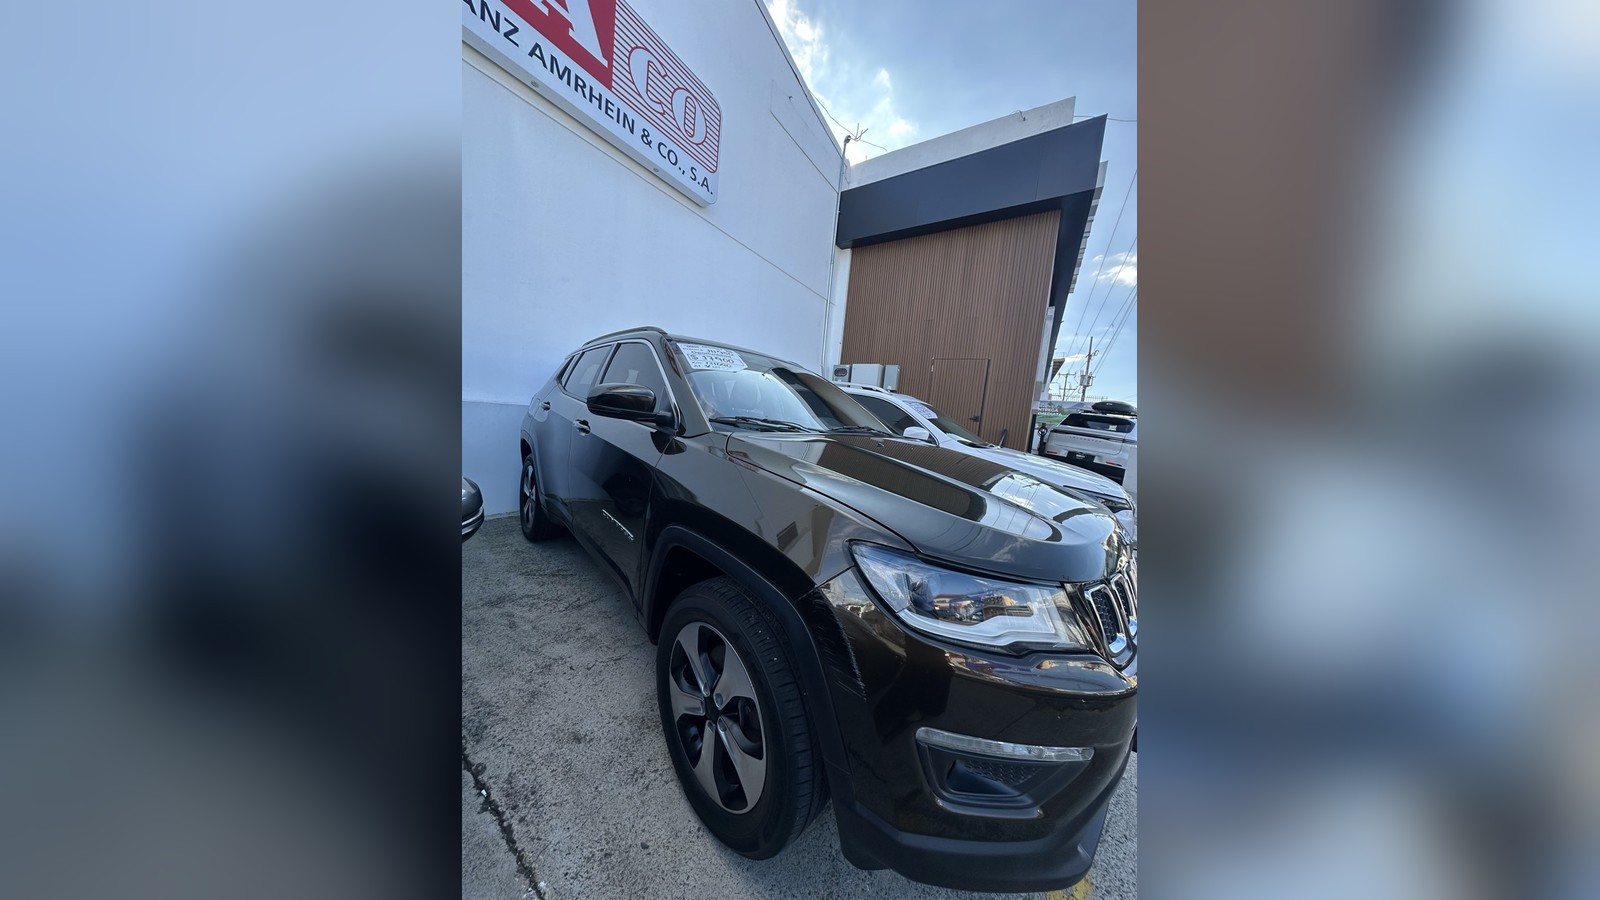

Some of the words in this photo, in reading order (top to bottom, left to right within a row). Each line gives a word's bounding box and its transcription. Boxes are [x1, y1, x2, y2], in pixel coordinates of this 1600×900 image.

[528, 41, 635, 135] AMRHEIN
[641, 128, 653, 148] &
[690, 166, 713, 195] S.A.
